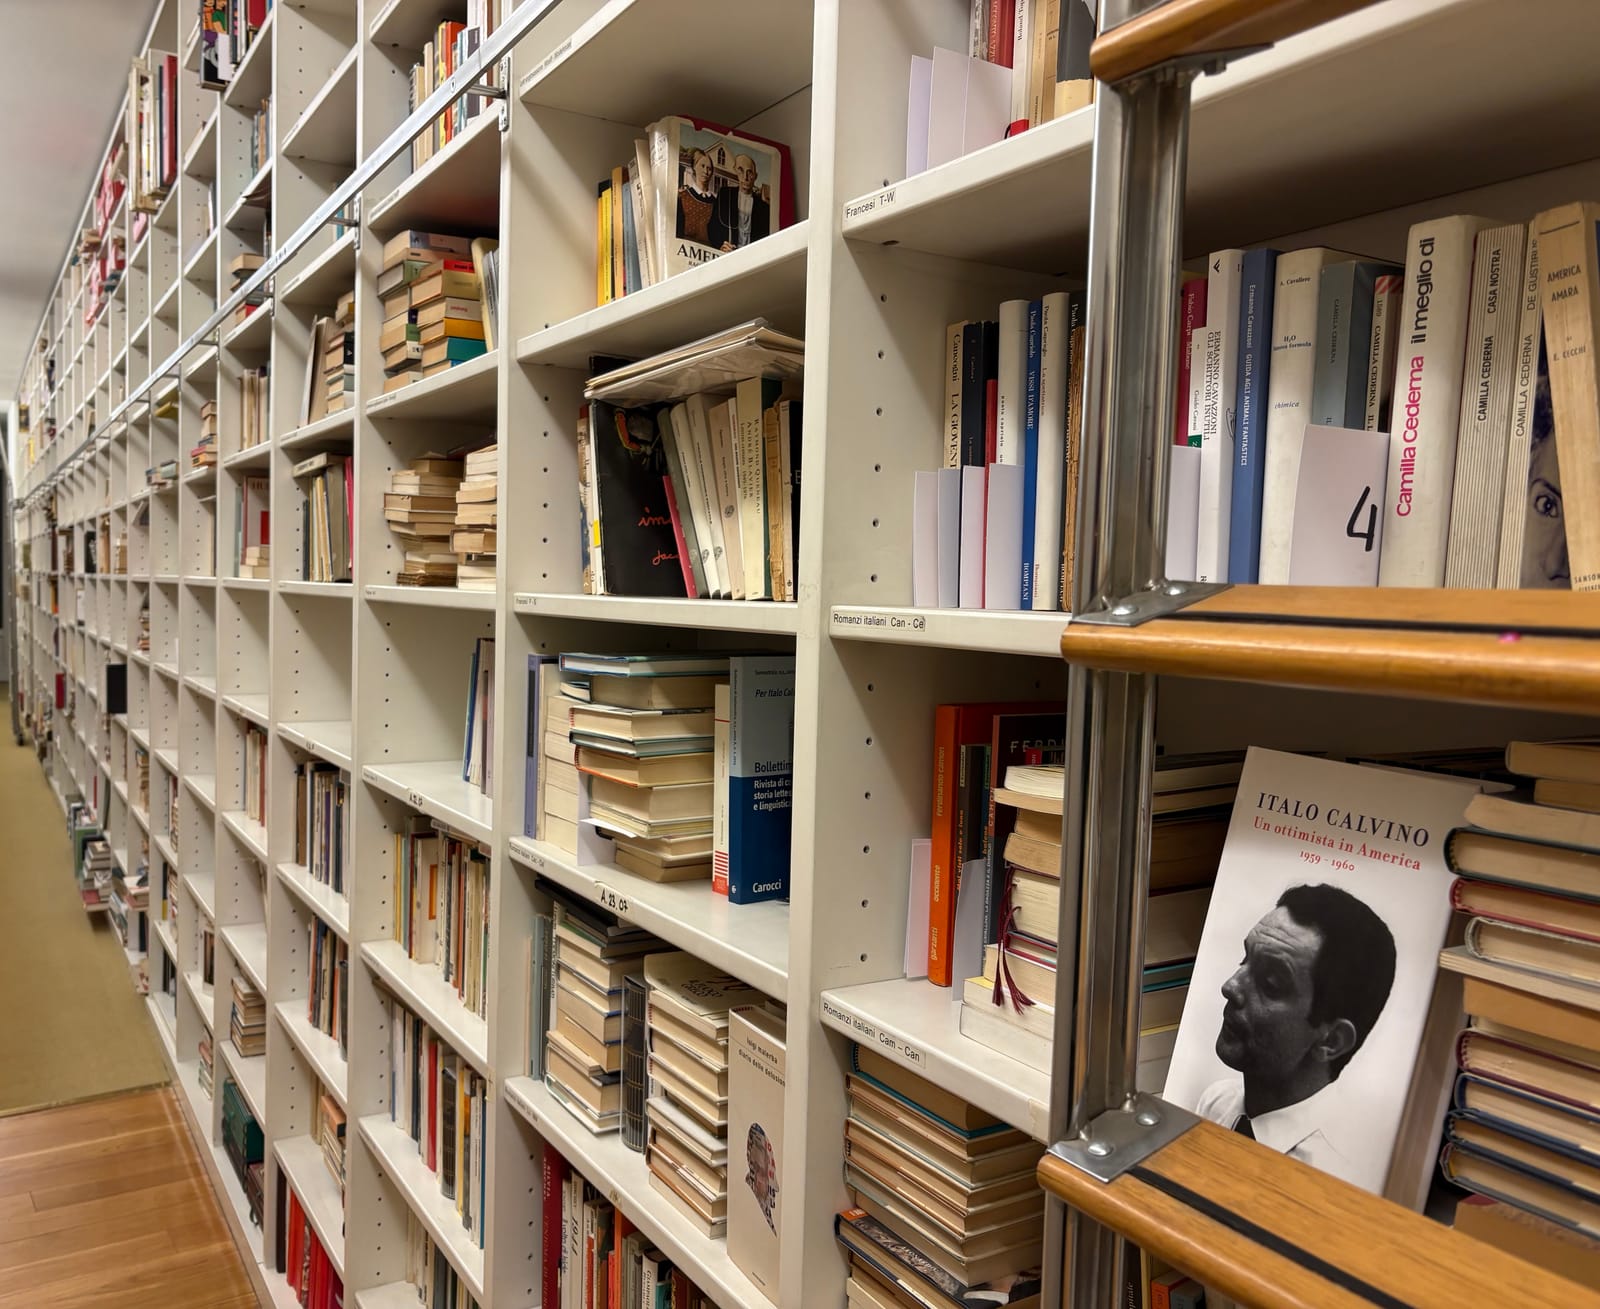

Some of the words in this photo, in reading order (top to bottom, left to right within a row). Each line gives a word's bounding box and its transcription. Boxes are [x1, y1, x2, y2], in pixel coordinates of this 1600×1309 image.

[846, 199, 876, 219] Francesi
[880, 191, 895, 206] T-W
[1420, 237, 1435, 257] di
[1491, 248, 1501, 287] NOSTRA
[1547, 264, 1582, 283] AMERICA
[1415, 260, 1434, 331] meglio
[1487, 288, 1498, 314] CASA
[1527, 294, 1536, 311] DE
[1551, 286, 1579, 302] AMARA
[1212, 331, 1222, 380] ERMANNO
[1372, 325, 1381, 365] CAMILLA
[1411, 334, 1426, 344] il
[1481, 336, 1494, 378] CEDERNA
[1204, 350, 1213, 401] SCRITTORI
[1244, 354, 1253, 376] GUIDA
[1519, 334, 1533, 386] CEDERNA
[1369, 366, 1378, 408] CEDERNA
[1403, 356, 1425, 444] Cederna
[1478, 379, 1490, 422] CAMILLA
[1203, 403, 1211, 441] INUTILI
[1210, 382, 1219, 434] CAVAZZONI
[1242, 396, 1250, 425] ANIMALI
[1516, 389, 1529, 437] CAMILLA
[1241, 426, 1249, 466] FANTASTICI
[1397, 446, 1416, 517] Camilla
[1346, 485, 1378, 553] 4
[833, 613, 861, 625] Romanzi
[864, 616, 886, 627] italiani
[890, 617, 905, 628] Can
[755, 688, 767, 698] Per
[768, 687, 783, 697] Italo
[753, 789, 773, 800] storia
[754, 780, 777, 790] Rivista
[777, 779, 784, 788] di
[753, 803, 758, 811] e
[1256, 792, 1319, 821] ITALO
[1326, 808, 1430, 847] CALVINO
[1254, 815, 1271, 832] Un
[1274, 823, 1335, 849] ottimista
[1338, 837, 1354, 853] in
[1357, 842, 1422, 871] America
[1300, 850, 1322, 865] 1959
[1331, 858, 1355, 872] 1960
[752, 878, 782, 893] Carocci
[823, 1002, 852, 1025] Romanzi
[853, 1017, 875, 1038] italiani
[879, 1033, 896, 1049] Cam
[904, 1046, 920, 1062] Can
[752, 1056, 764, 1073] delle
[757, 1044, 778, 1065] malerba
